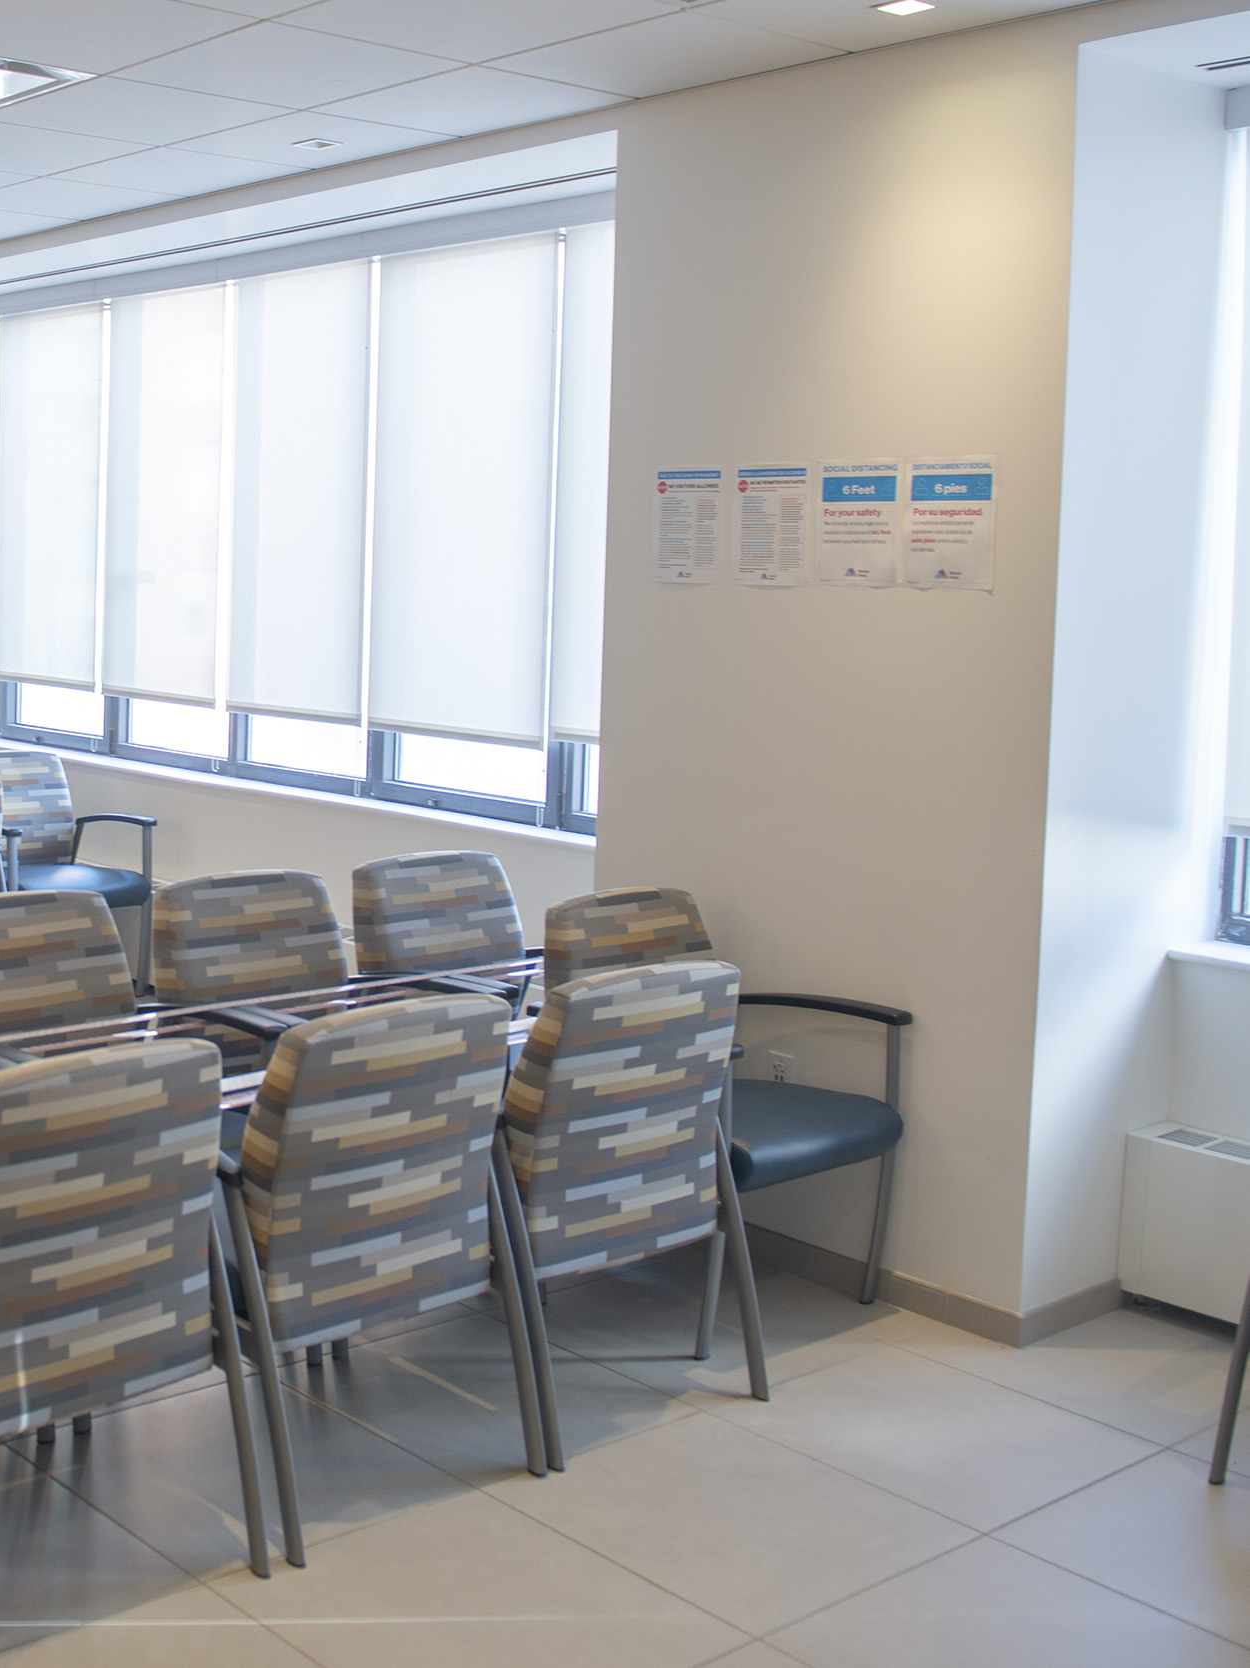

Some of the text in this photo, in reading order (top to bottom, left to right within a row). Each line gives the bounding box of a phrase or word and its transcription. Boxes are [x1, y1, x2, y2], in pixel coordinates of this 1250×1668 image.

[823, 464, 898, 473] SOCIAL DISTANCING
[842, 484, 876, 495] 6 Feet
[934, 482, 968, 496] 6 pies
[823, 508, 837, 517] For
[837, 510, 855, 518] your
[912, 507, 927, 516] Por
